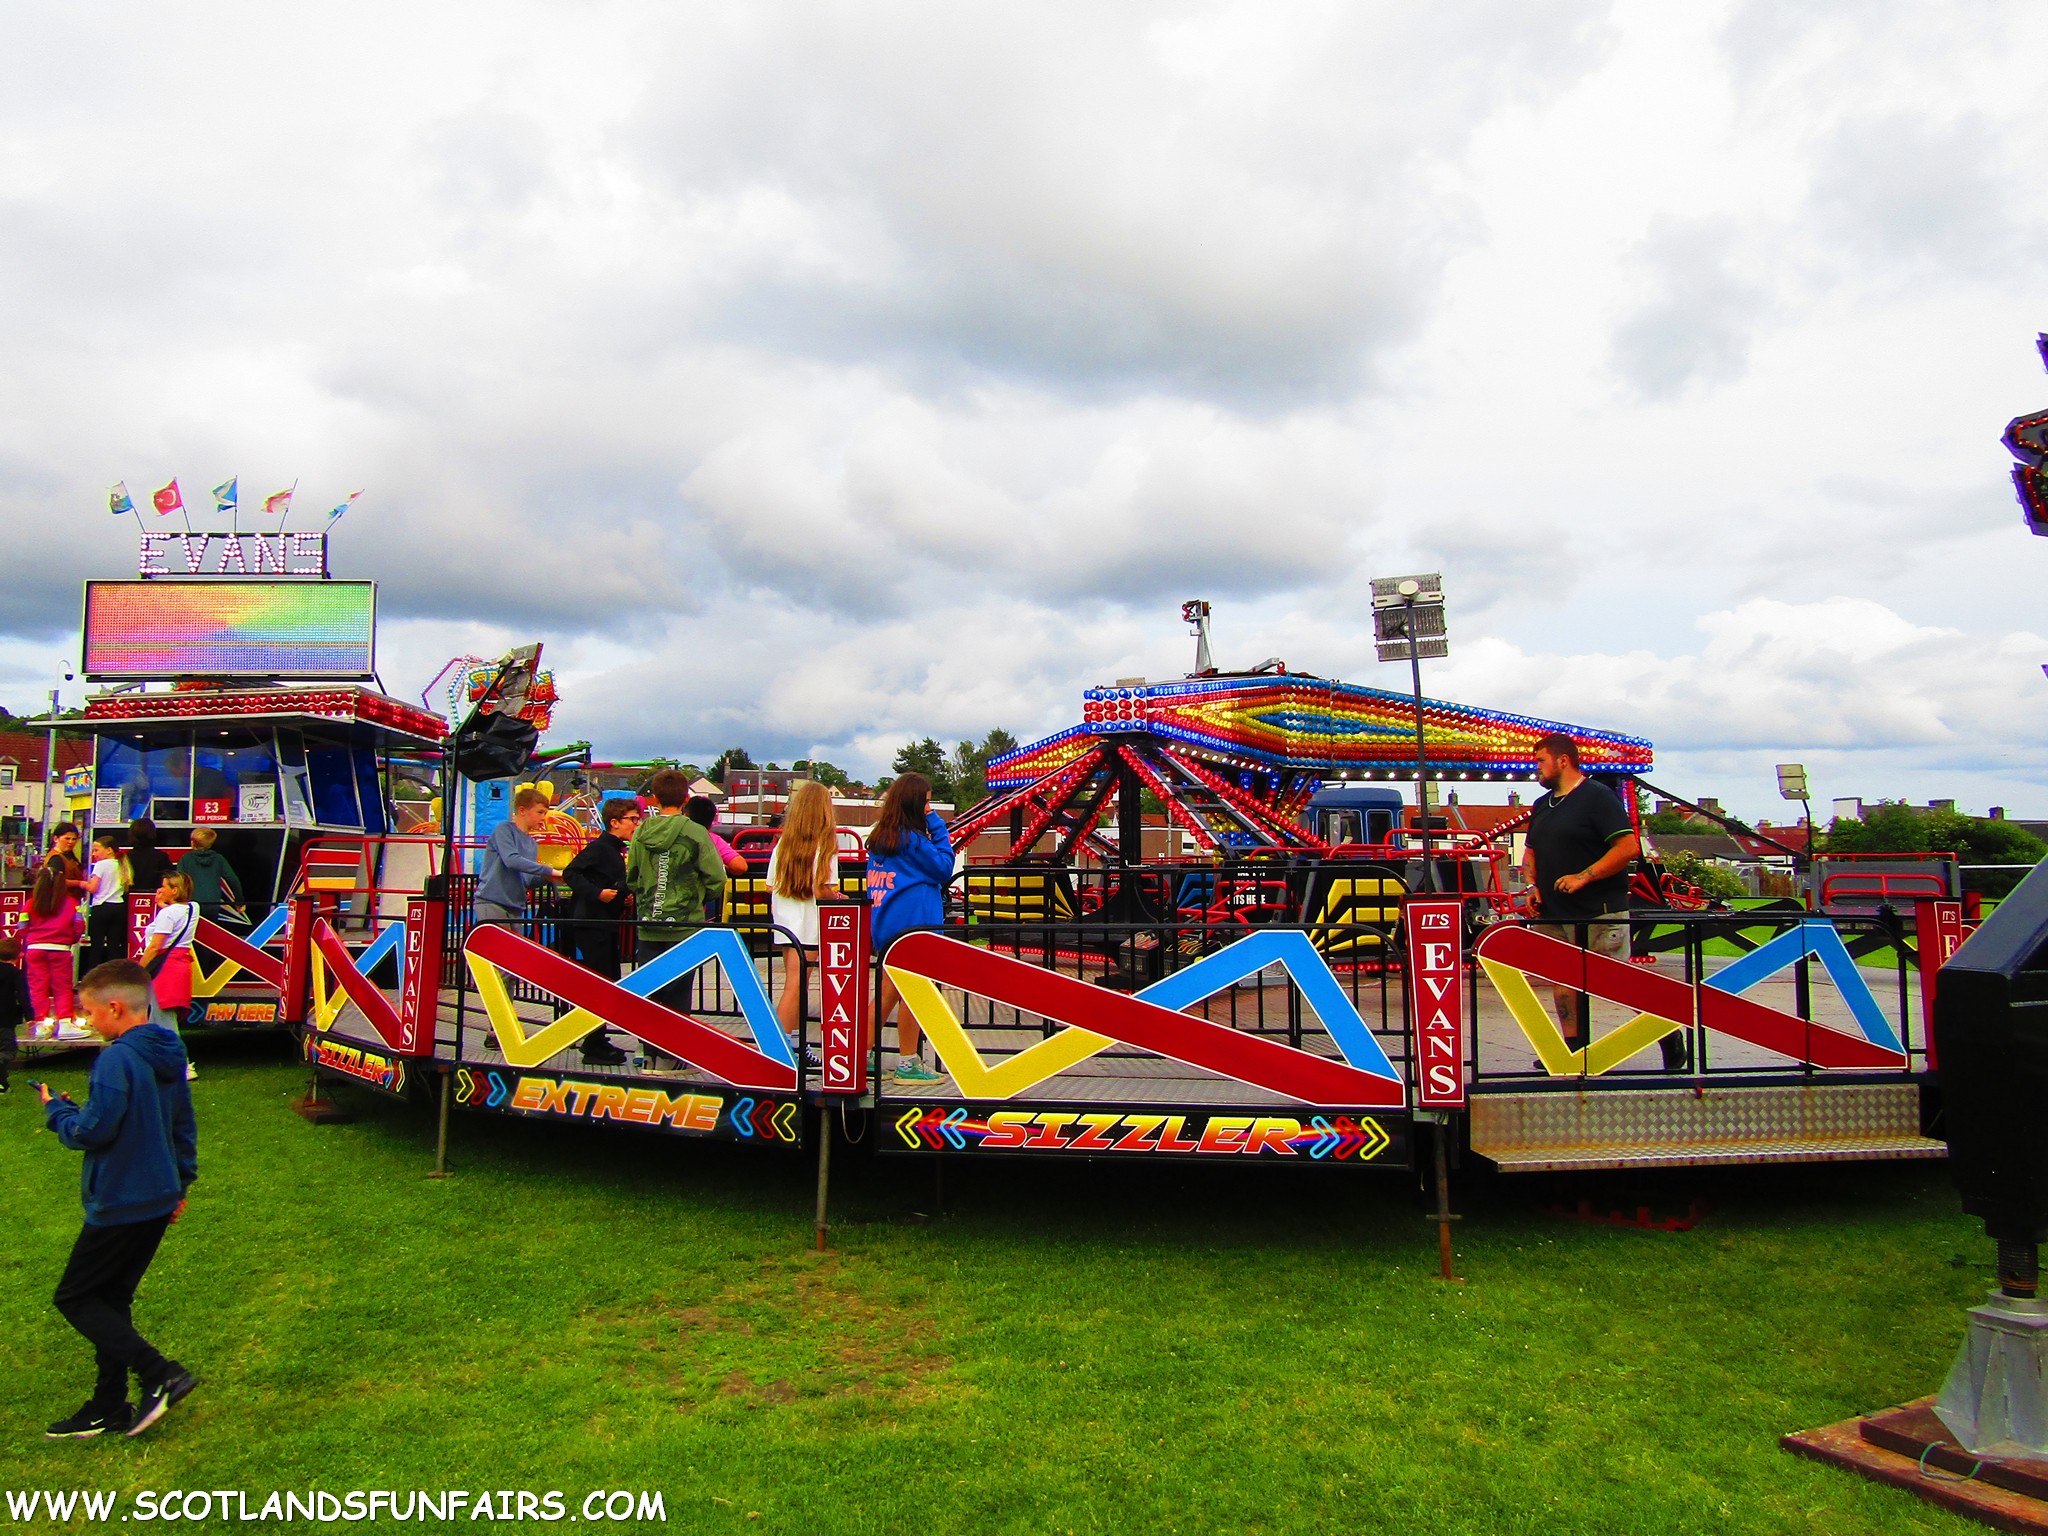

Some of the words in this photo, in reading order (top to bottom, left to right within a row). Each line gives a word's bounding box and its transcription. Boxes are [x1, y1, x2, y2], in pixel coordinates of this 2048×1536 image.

[140, 533, 323, 574] EVANS
[204, 802, 219, 813] £3
[828, 915, 851, 926] IT'S
[1246, 894, 1266, 905] HEE
[1421, 912, 1450, 926] IT'S
[132, 913, 151, 958] EVA
[402, 931, 421, 1045] EVANS
[205, 1003, 237, 1021] PAY
[236, 1003, 277, 1022] HERE
[826, 941, 853, 1083] EVANS
[1421, 942, 1457, 1095] EVANS
[317, 1040, 388, 1084] SIZZLER
[510, 1076, 724, 1131] EXTREME
[979, 1111, 1301, 1155] SIZZLER
